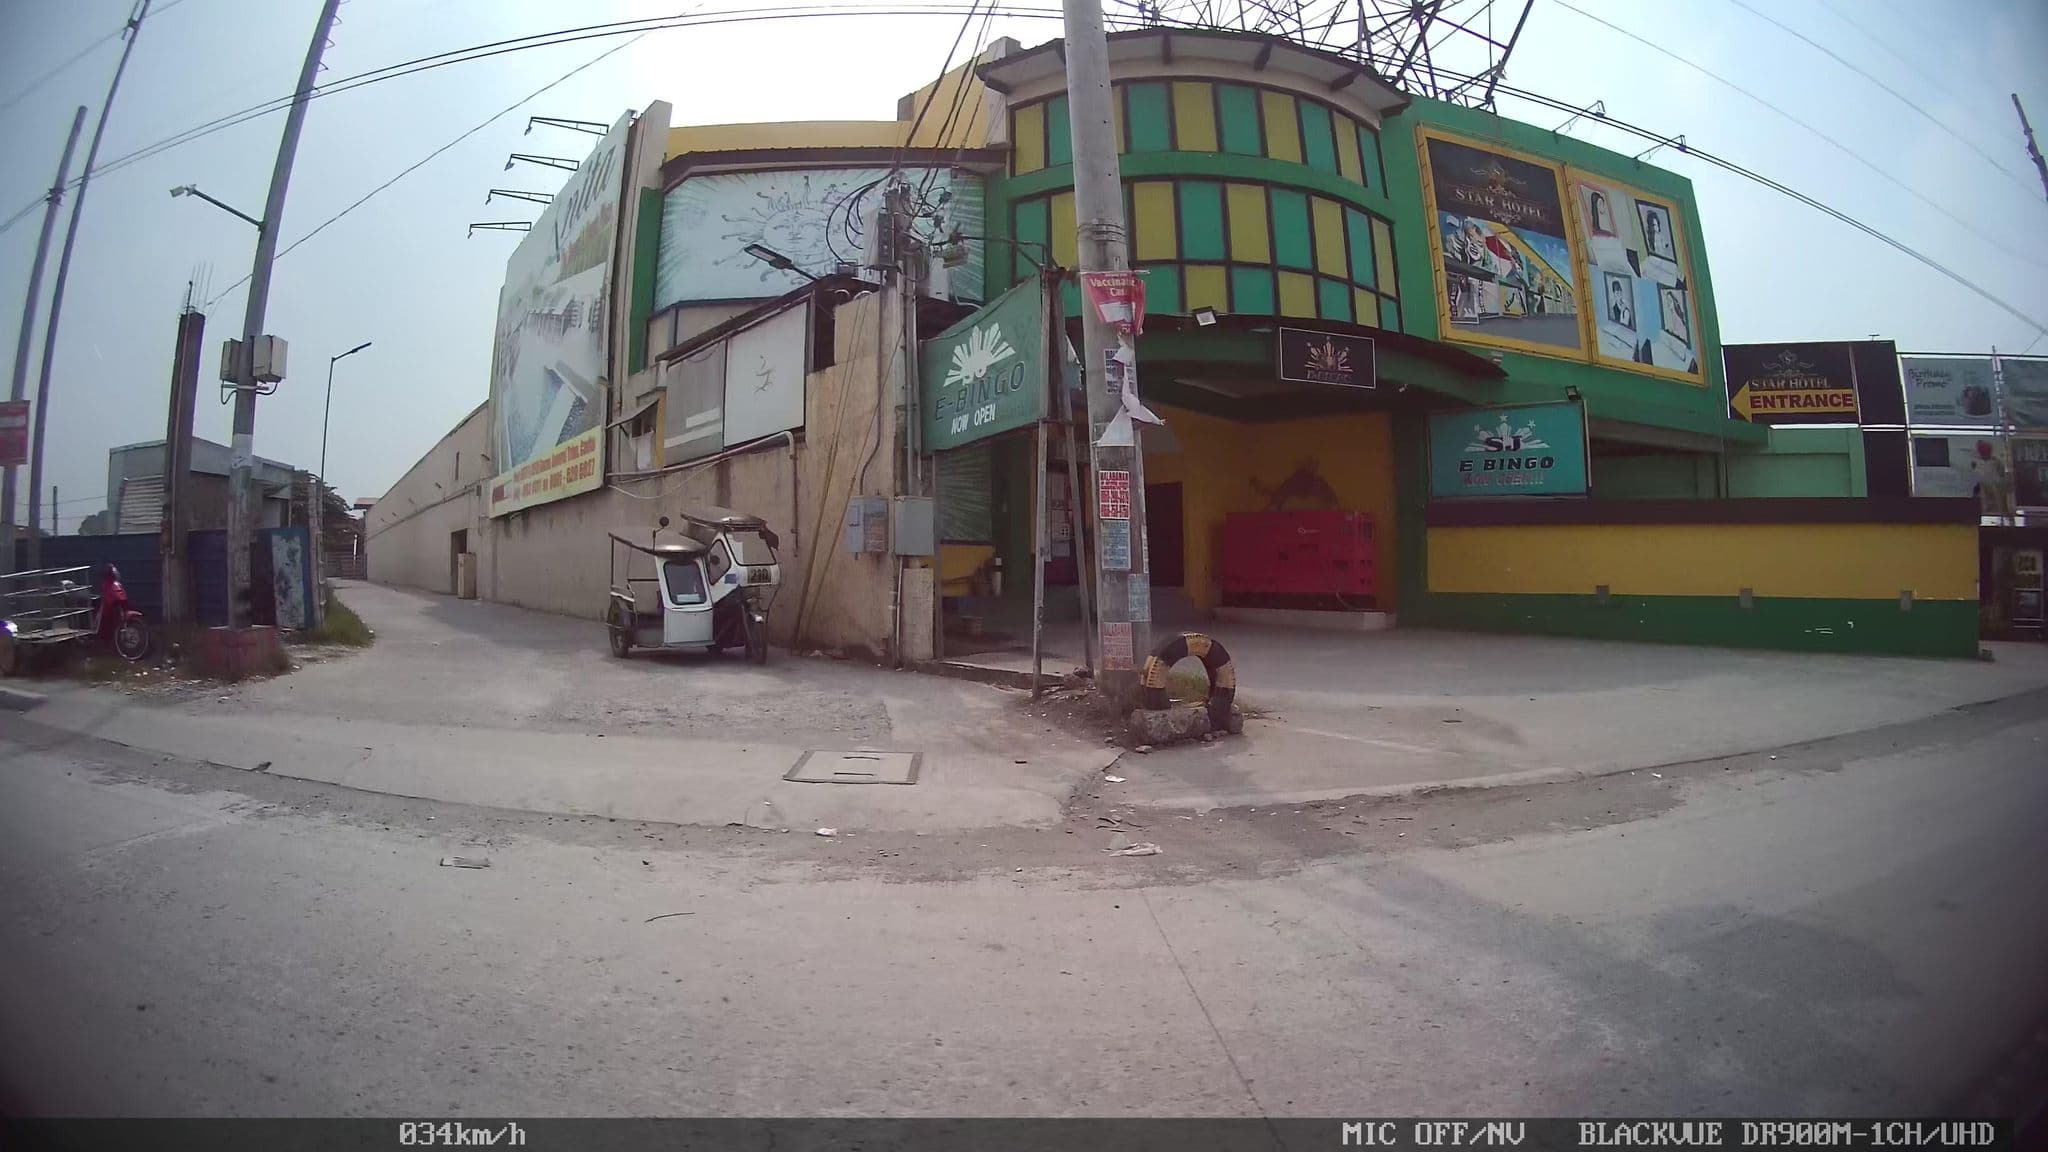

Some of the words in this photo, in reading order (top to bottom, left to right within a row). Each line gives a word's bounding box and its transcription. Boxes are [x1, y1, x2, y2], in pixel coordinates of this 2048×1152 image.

[1455, 188, 1495, 207] STAR
[1502, 201, 1544, 219] HOTEL
[936, 360, 1025, 421] E-BINGO
[1751, 378, 1786, 390] STAR
[1789, 376, 1831, 389] HOTEL
[1750, 393, 1854, 409] ENTRANCE
[950, 413, 969, 435] NOW
[973, 403, 996, 426] OPEN
[1483, 435, 1523, 453] SJ
[1459, 459, 1474, 473] E
[1483, 456, 1555, 472] BINGO
